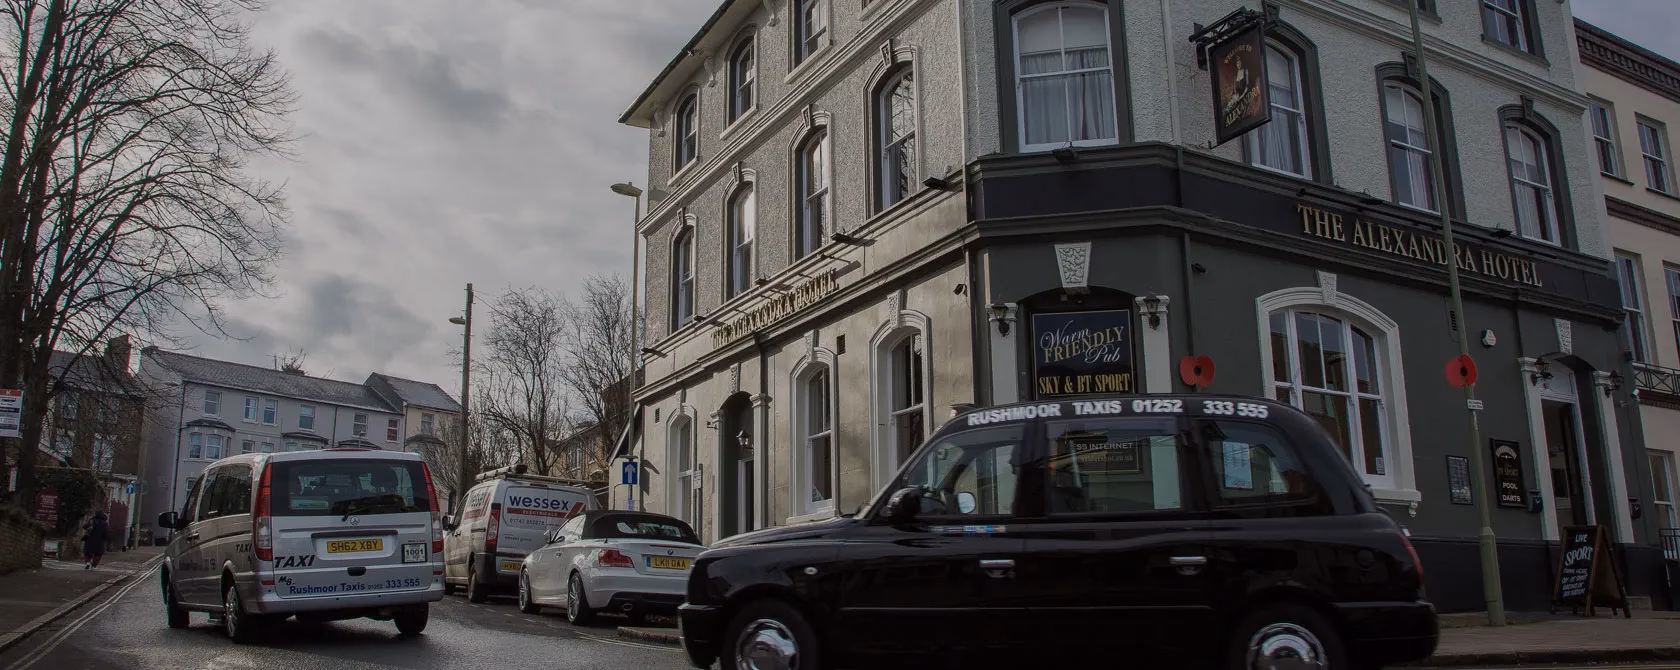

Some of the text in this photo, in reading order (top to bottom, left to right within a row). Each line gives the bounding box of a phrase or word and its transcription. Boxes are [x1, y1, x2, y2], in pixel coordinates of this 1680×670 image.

[1297, 206, 1542, 287] THE ALEXANDRA HOTEL
[1040, 320, 1090, 350] Warm
[1044, 326, 1124, 364] FRIENDLY
[1084, 344, 1120, 364] Pub
[1039, 373, 1130, 394] SKY & BT SPORT
[968, 400, 1269, 426] RUSHMOOR TAXIS 01252 333 555
[509, 496, 570, 511] wessex
[331, 540, 378, 552] SH62 XBY
[1575, 534, 1588, 542] LIVE
[236, 543, 252, 554] TAXI
[1565, 546, 1593, 566] SPORT
[275, 555, 315, 568] TAXI
[290, 585, 337, 594] Rushmoor
[340, 582, 365, 591] Taxis
[386, 580, 402, 589] 333
[404, 578, 420, 587] 555
